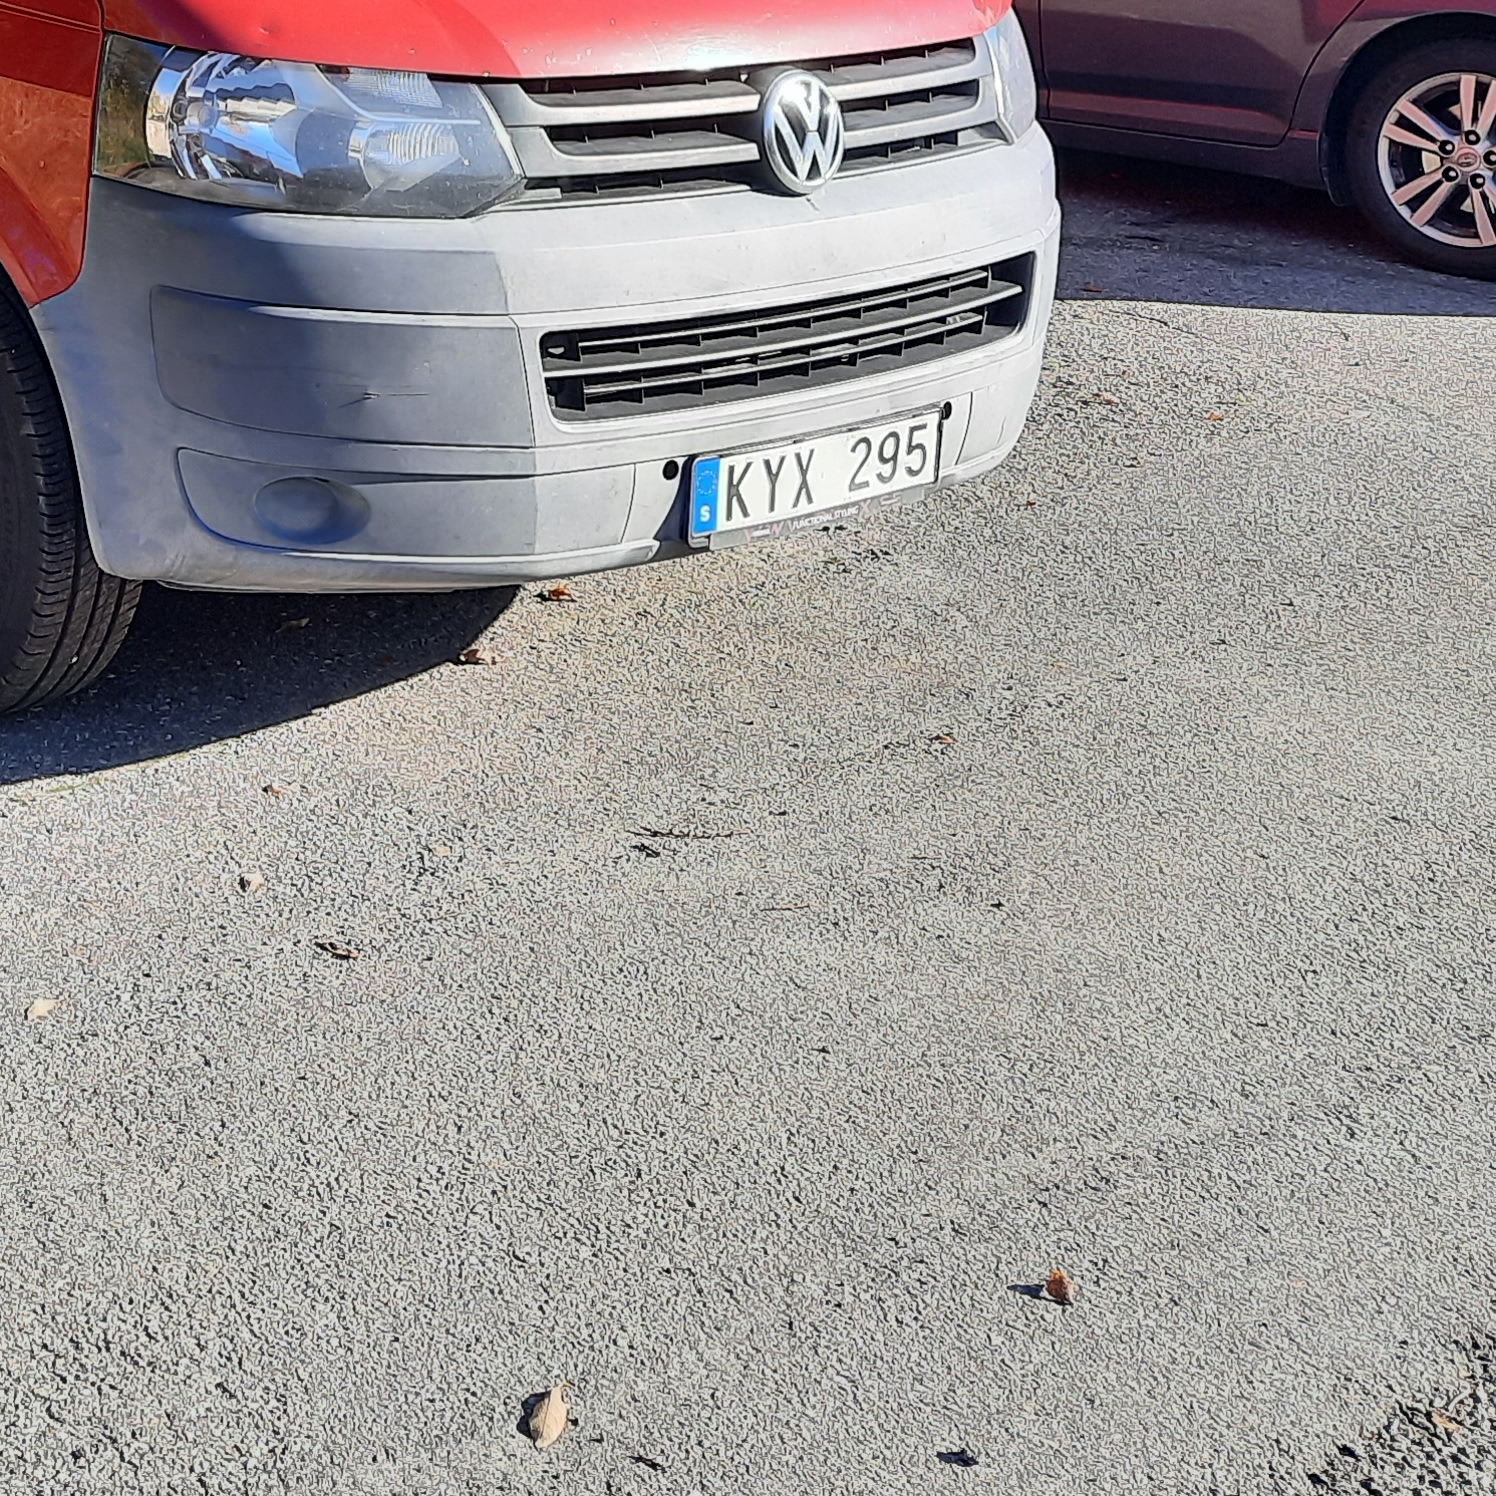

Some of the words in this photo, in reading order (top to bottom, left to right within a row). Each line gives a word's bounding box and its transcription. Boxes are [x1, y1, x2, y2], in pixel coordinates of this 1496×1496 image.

[726, 449, 814, 522] KYX
[848, 422, 928, 493] 295
[700, 505, 710, 521] S
